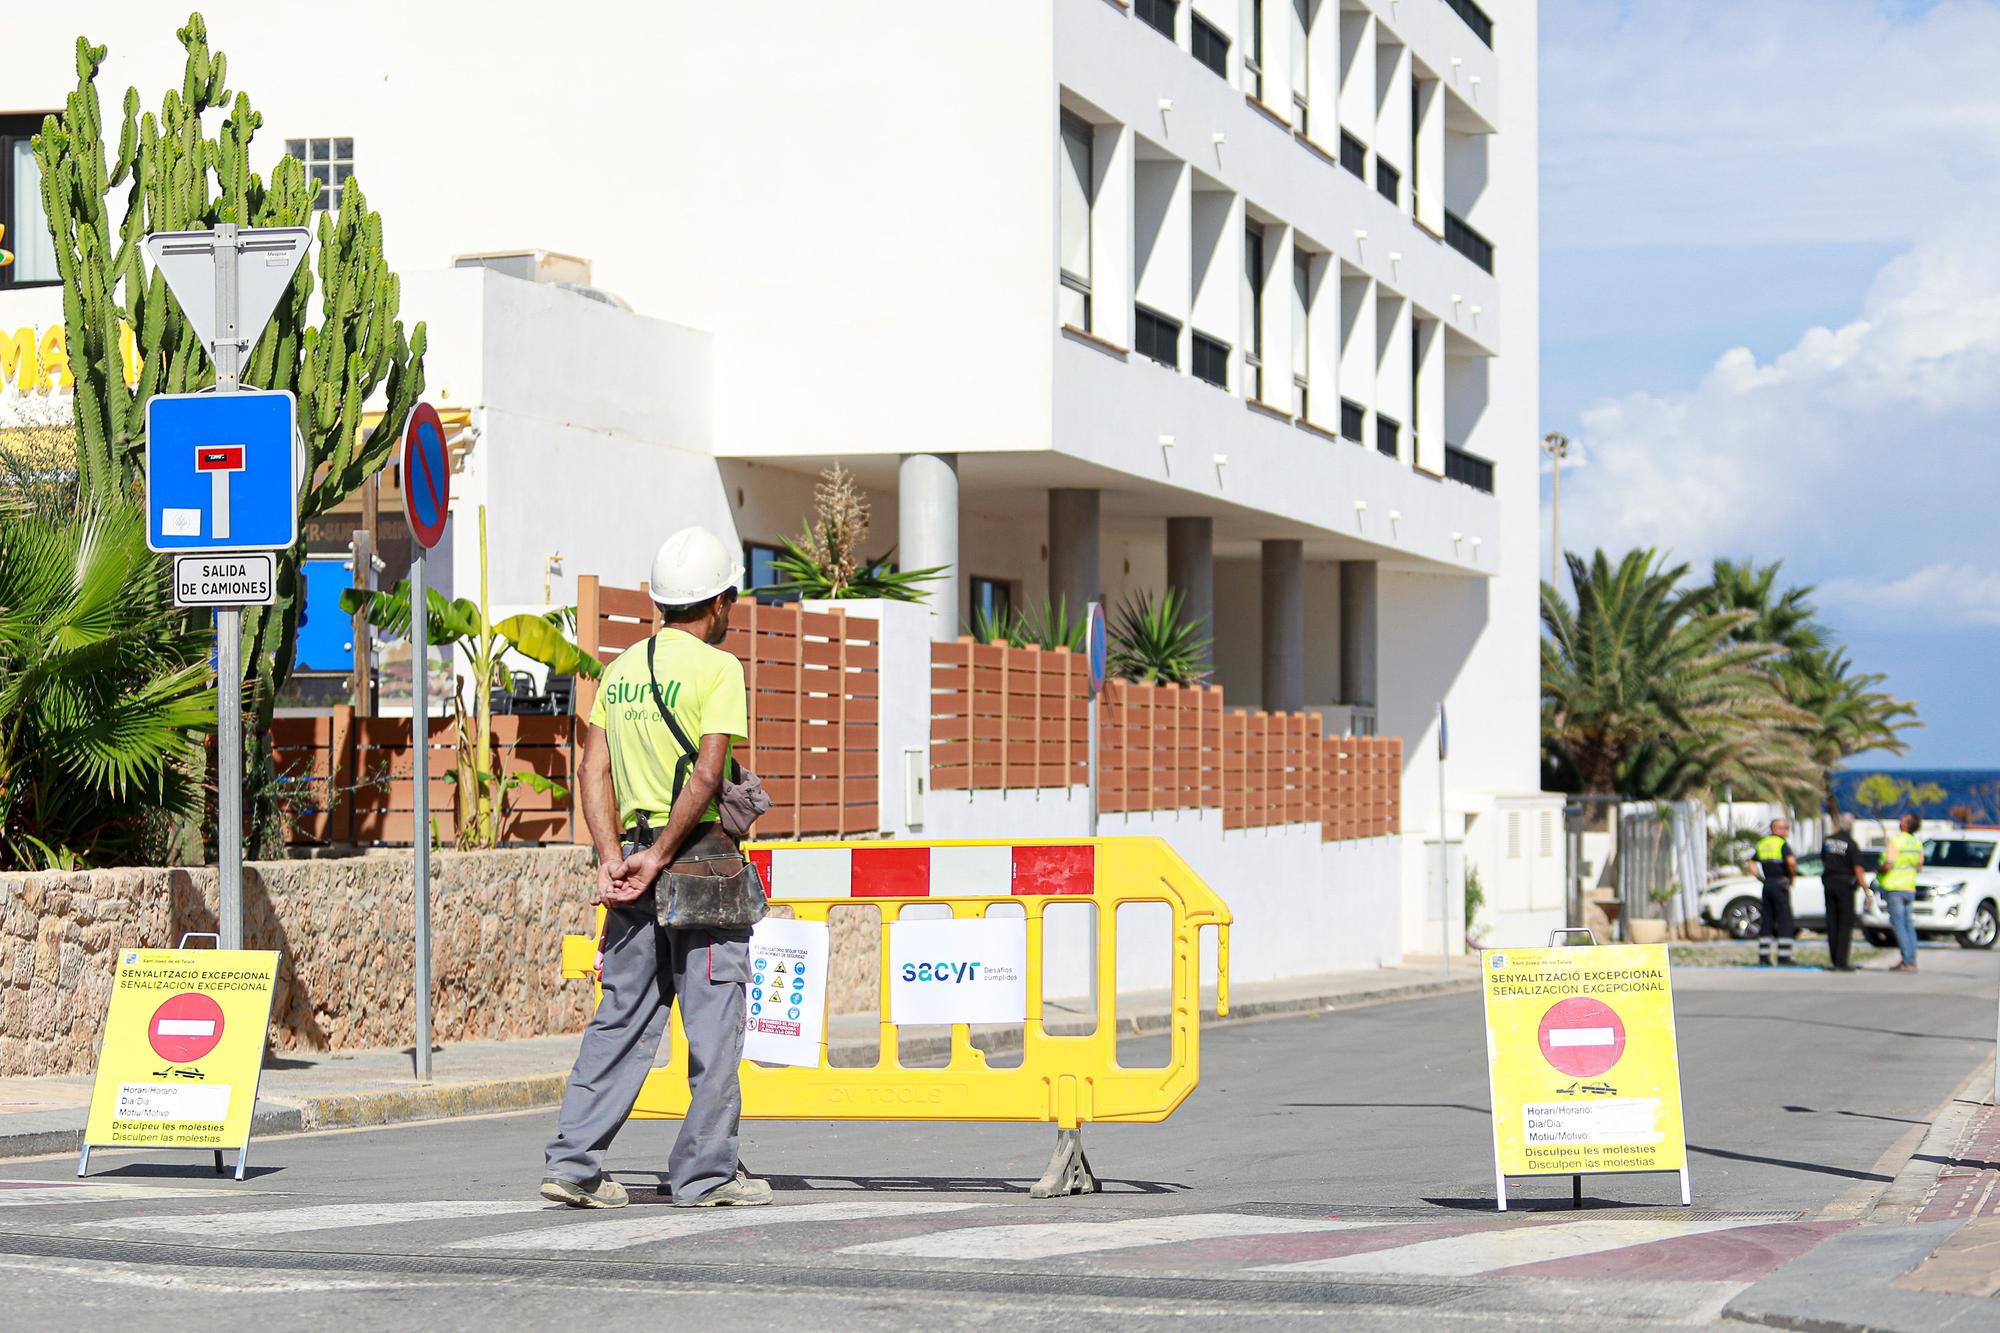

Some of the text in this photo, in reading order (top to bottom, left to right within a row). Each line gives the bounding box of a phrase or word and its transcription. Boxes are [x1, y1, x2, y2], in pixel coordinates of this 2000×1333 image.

[202, 564, 247, 577] SALIDA
[181, 581, 267, 595] DE CAMIONES
[121, 969, 270, 980] SENYALITZACIÓ EXCEPCIONAL
[902, 962, 981, 983] sacyr
[984, 974, 1017, 982] cumplidos
[1491, 970, 1663, 983] SENYALITZACIÓ EXCEPCIONAL
[197, 982, 268, 991] EXCEPCIONAL
[1493, 982, 1664, 996] SEÑALIZACIÓN EXCEPCIONAL
[112, 1121, 159, 1131] Disculpeu
[162, 1122, 176, 1130] les
[112, 1132, 221, 1142] Disculpen las molestias
[1525, 1147, 1580, 1157] Disculpeu
[1584, 1146, 1599, 1155] les
[1528, 1157, 1655, 1170] Disculpen las molestias
